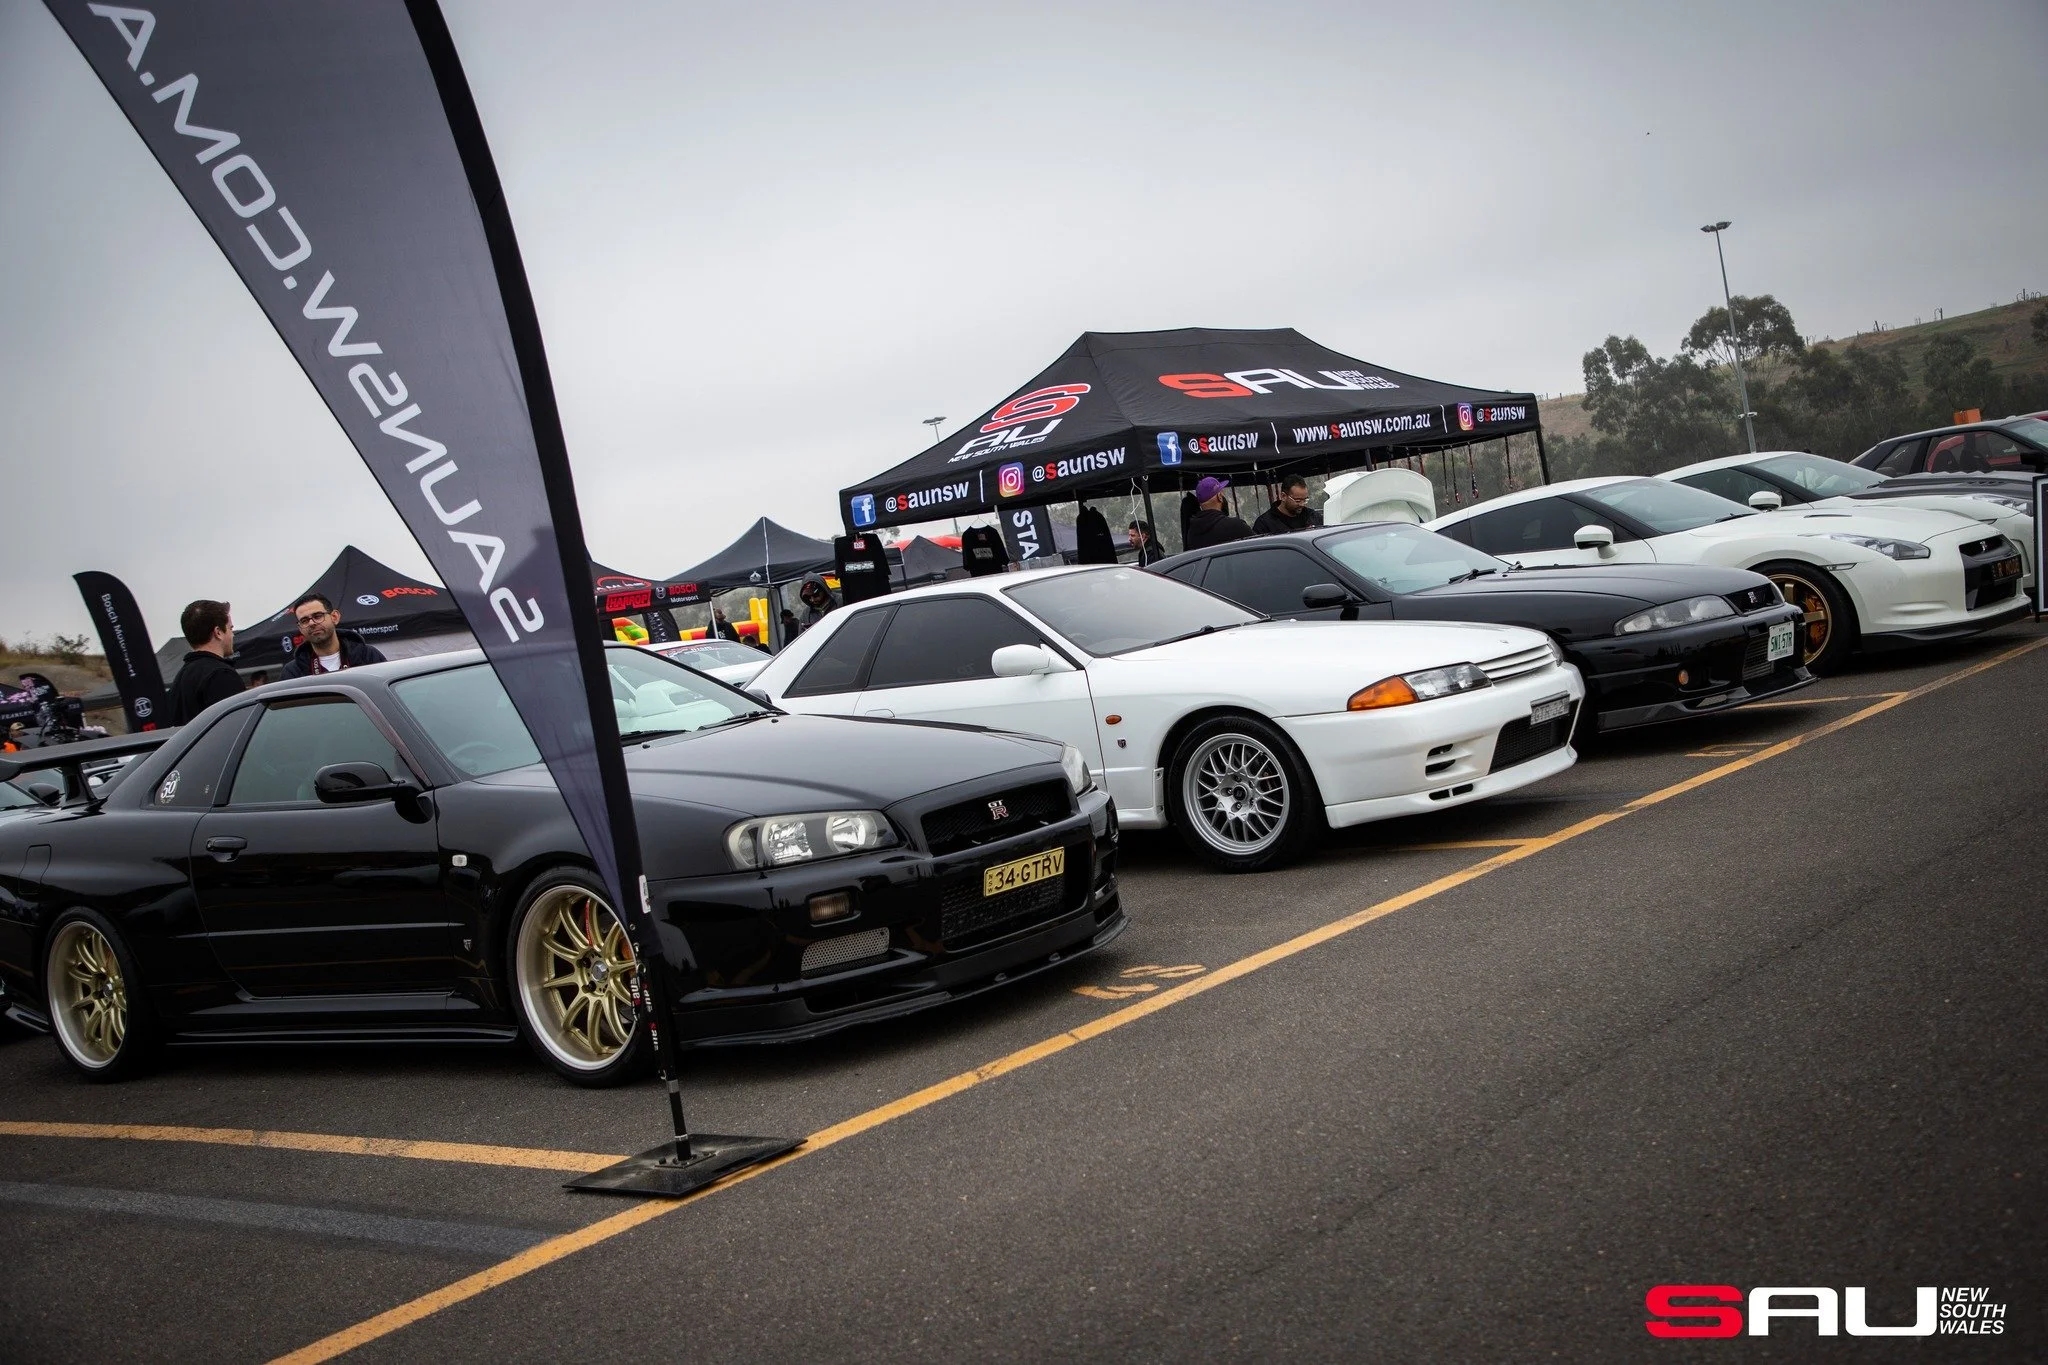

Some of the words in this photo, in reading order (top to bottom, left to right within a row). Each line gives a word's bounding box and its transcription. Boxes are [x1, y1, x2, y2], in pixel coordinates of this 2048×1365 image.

[1158, 368, 1364, 398] SAU
[1476, 405, 1526, 423] @saunsw
[1293, 413, 1431, 444] www.saunsw.com.au
[1188, 431, 1259, 454] @saunsw
[1031, 446, 1127, 482] @saunsw
[885, 481, 970, 513] @saunsw
[381, 587, 439, 599] BOSCH
[669, 584, 697, 595] BOSCH
[670, 595, 700, 603] Motorsport
[101, 593, 119, 624] Bosch
[113, 624, 137, 677] Motorsport
[358, 624, 400, 636] Motorsport
